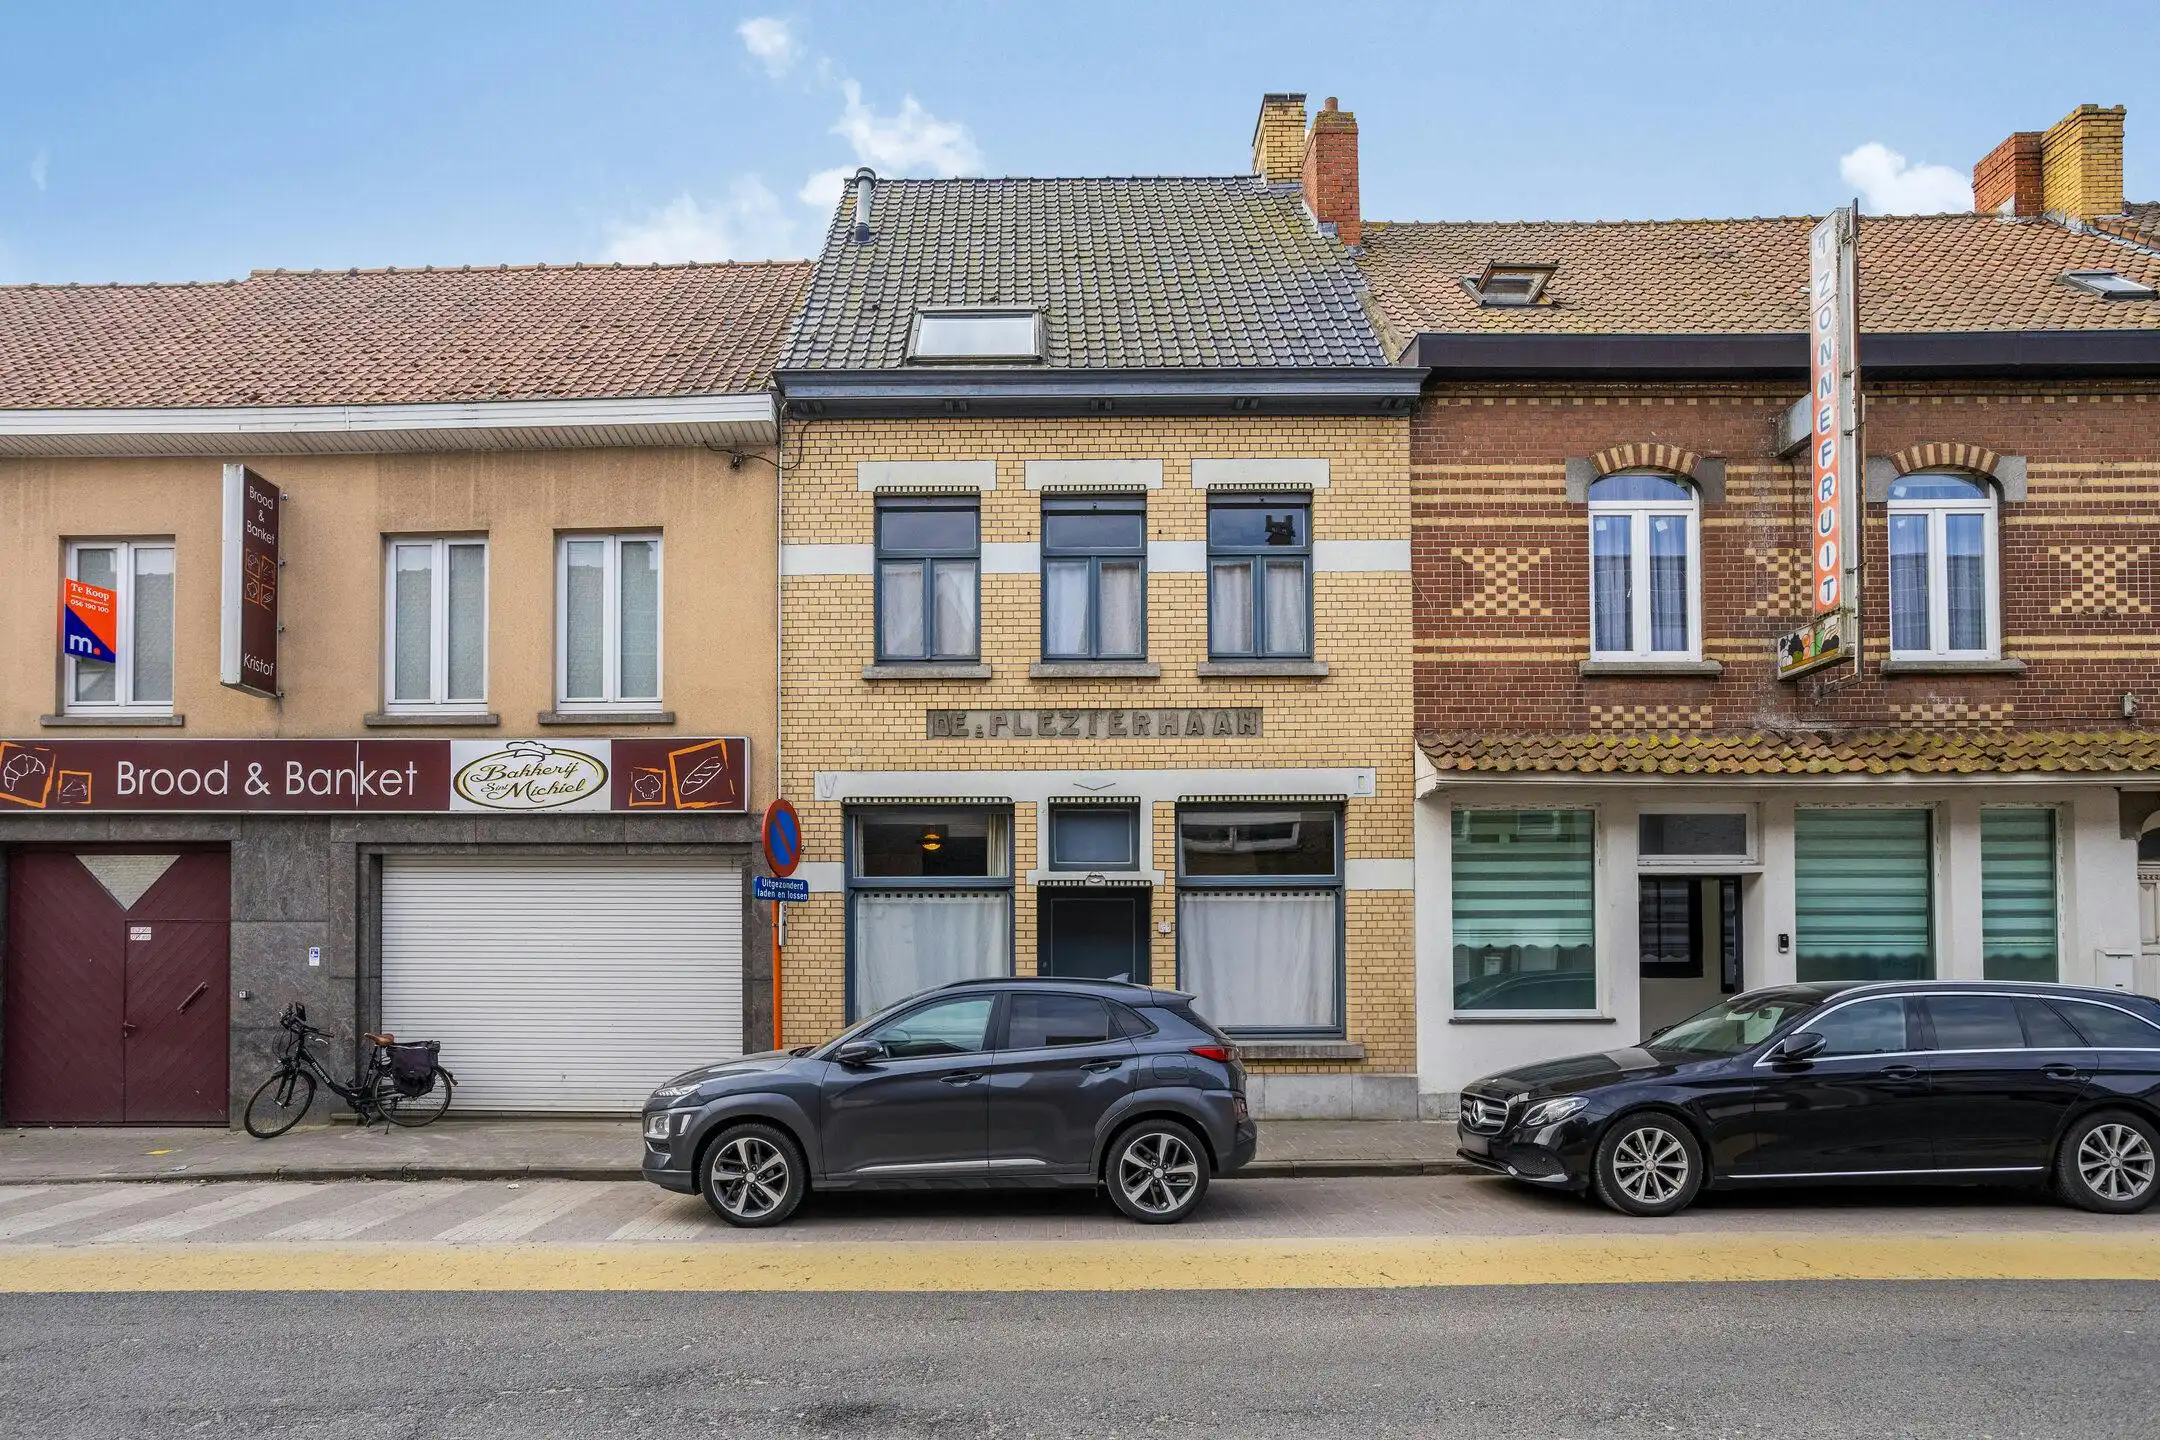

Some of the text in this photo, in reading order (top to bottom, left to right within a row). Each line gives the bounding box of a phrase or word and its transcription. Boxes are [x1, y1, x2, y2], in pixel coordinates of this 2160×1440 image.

[249, 485, 274, 510] Brood
[258, 509, 265, 523] &
[247, 519, 275, 545] Banket
[70, 582, 83, 594] Te
[85, 586, 110, 602] Koop
[243, 652, 274, 677] Kristof
[117, 760, 418, 796] Brood & Banket
[470, 761, 580, 783] Bakkerij
[480, 778, 586, 804] Sint Michiel
[757, 888, 808, 900] laden en lossen
[761, 879, 804, 891] Uitgezonderd
